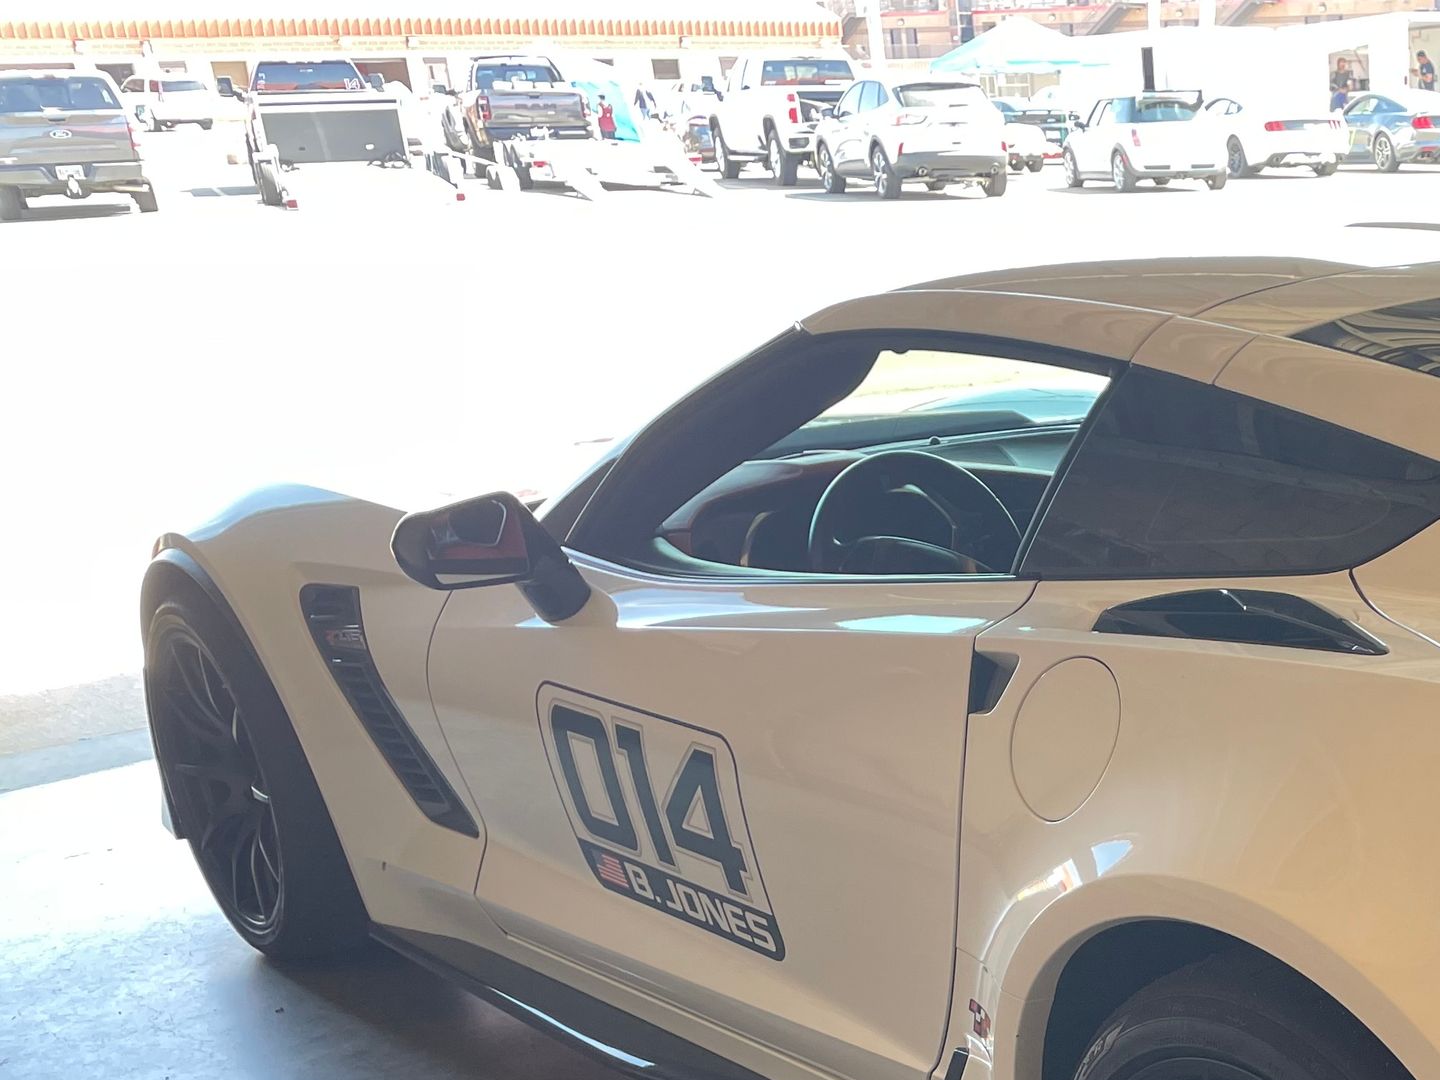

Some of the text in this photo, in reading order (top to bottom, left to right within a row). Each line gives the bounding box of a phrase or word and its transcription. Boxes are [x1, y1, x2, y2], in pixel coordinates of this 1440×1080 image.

[549, 699, 752, 902] 014
[623, 861, 777, 952] B. JONES
